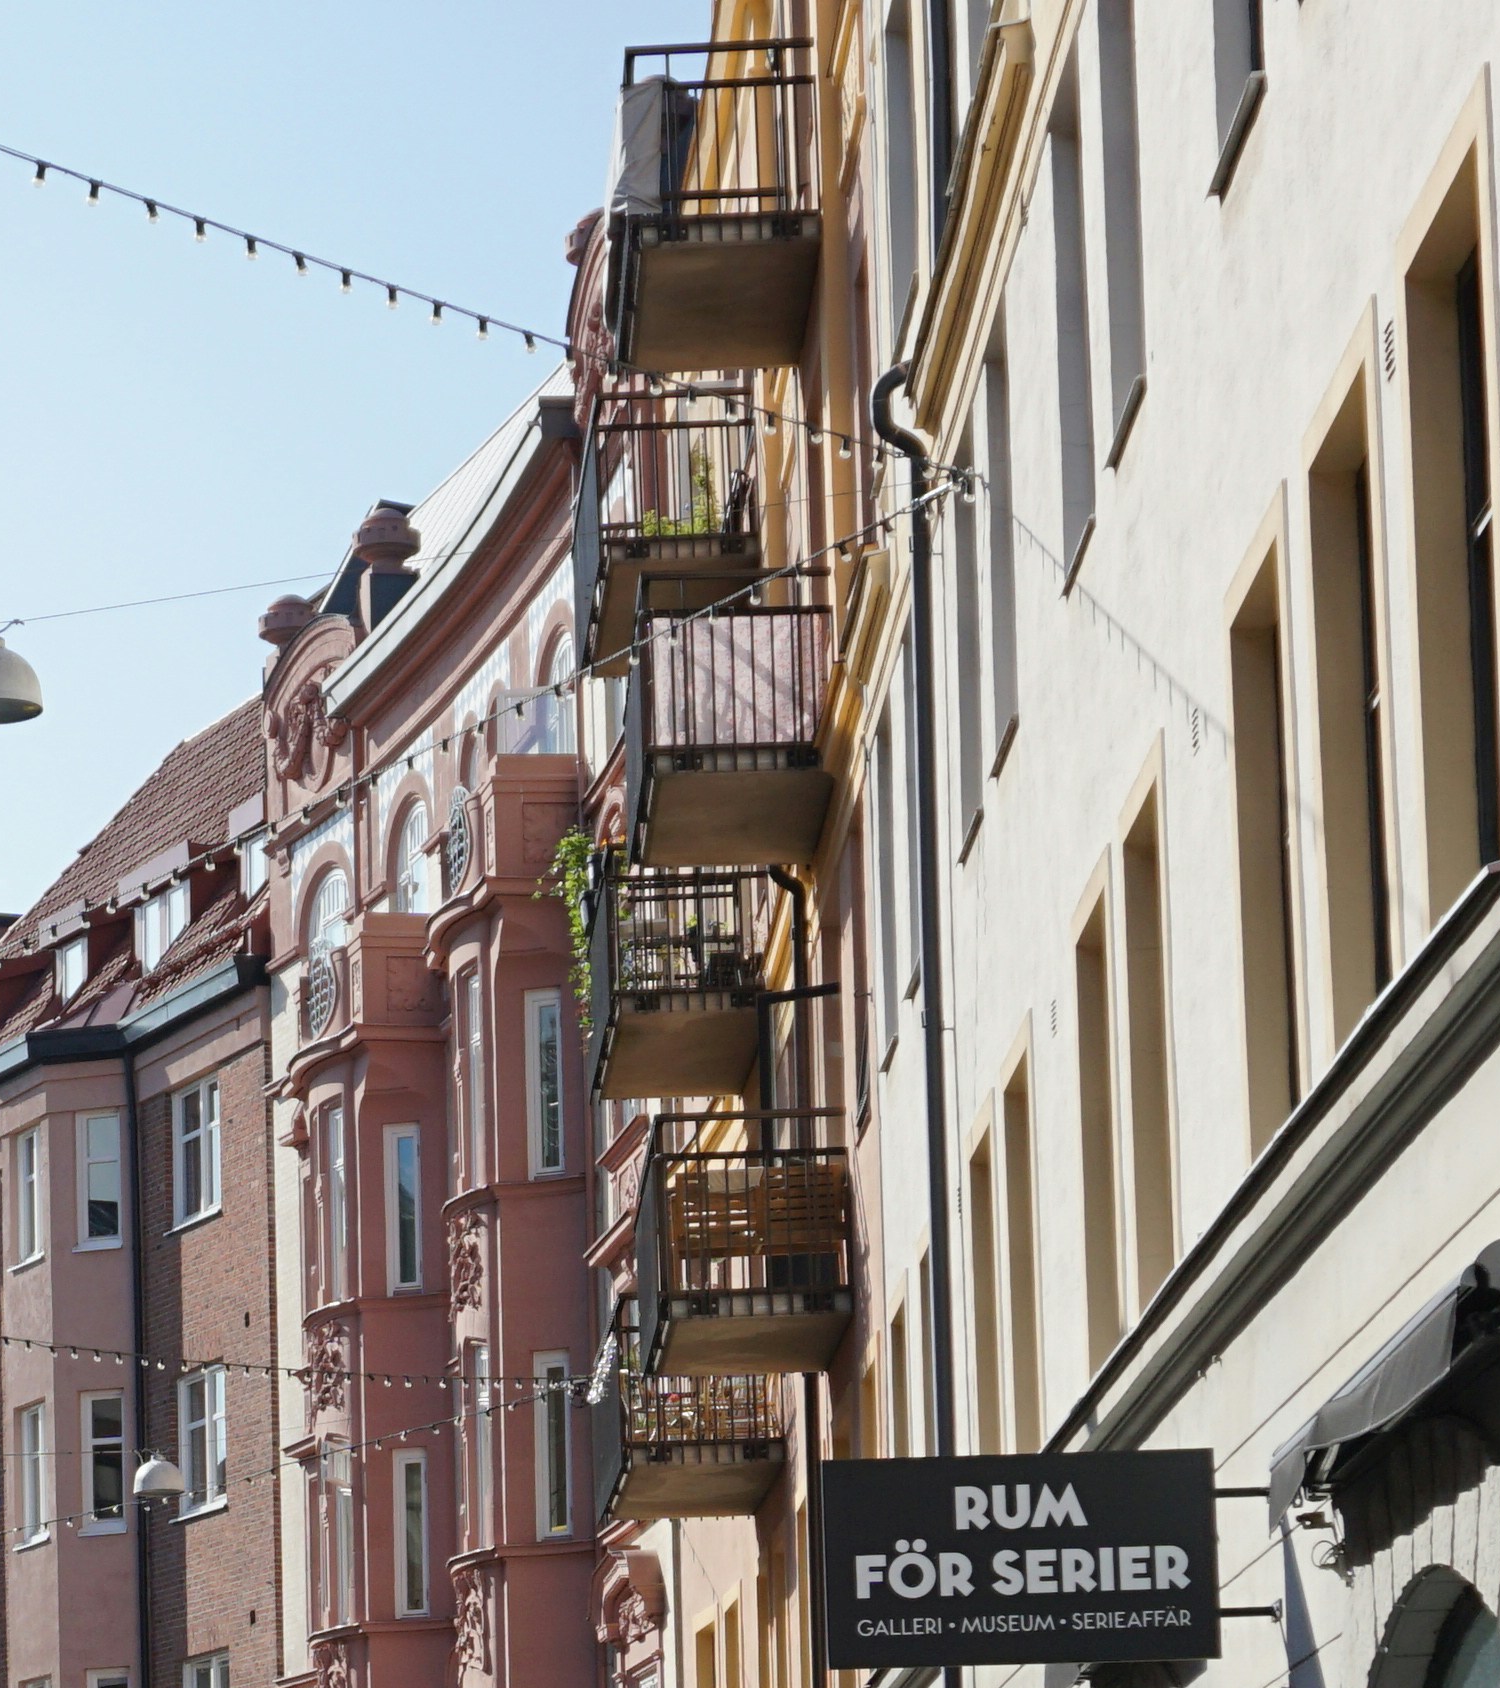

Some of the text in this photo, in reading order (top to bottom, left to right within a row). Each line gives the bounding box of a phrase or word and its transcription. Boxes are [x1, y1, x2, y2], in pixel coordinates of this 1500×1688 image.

[954, 1482, 1088, 1530] RUM
[855, 1538, 1191, 1599] FÖR SERIER
[857, 1605, 1192, 1637] GALLERI MUSEUM SERIEAFFÄR
